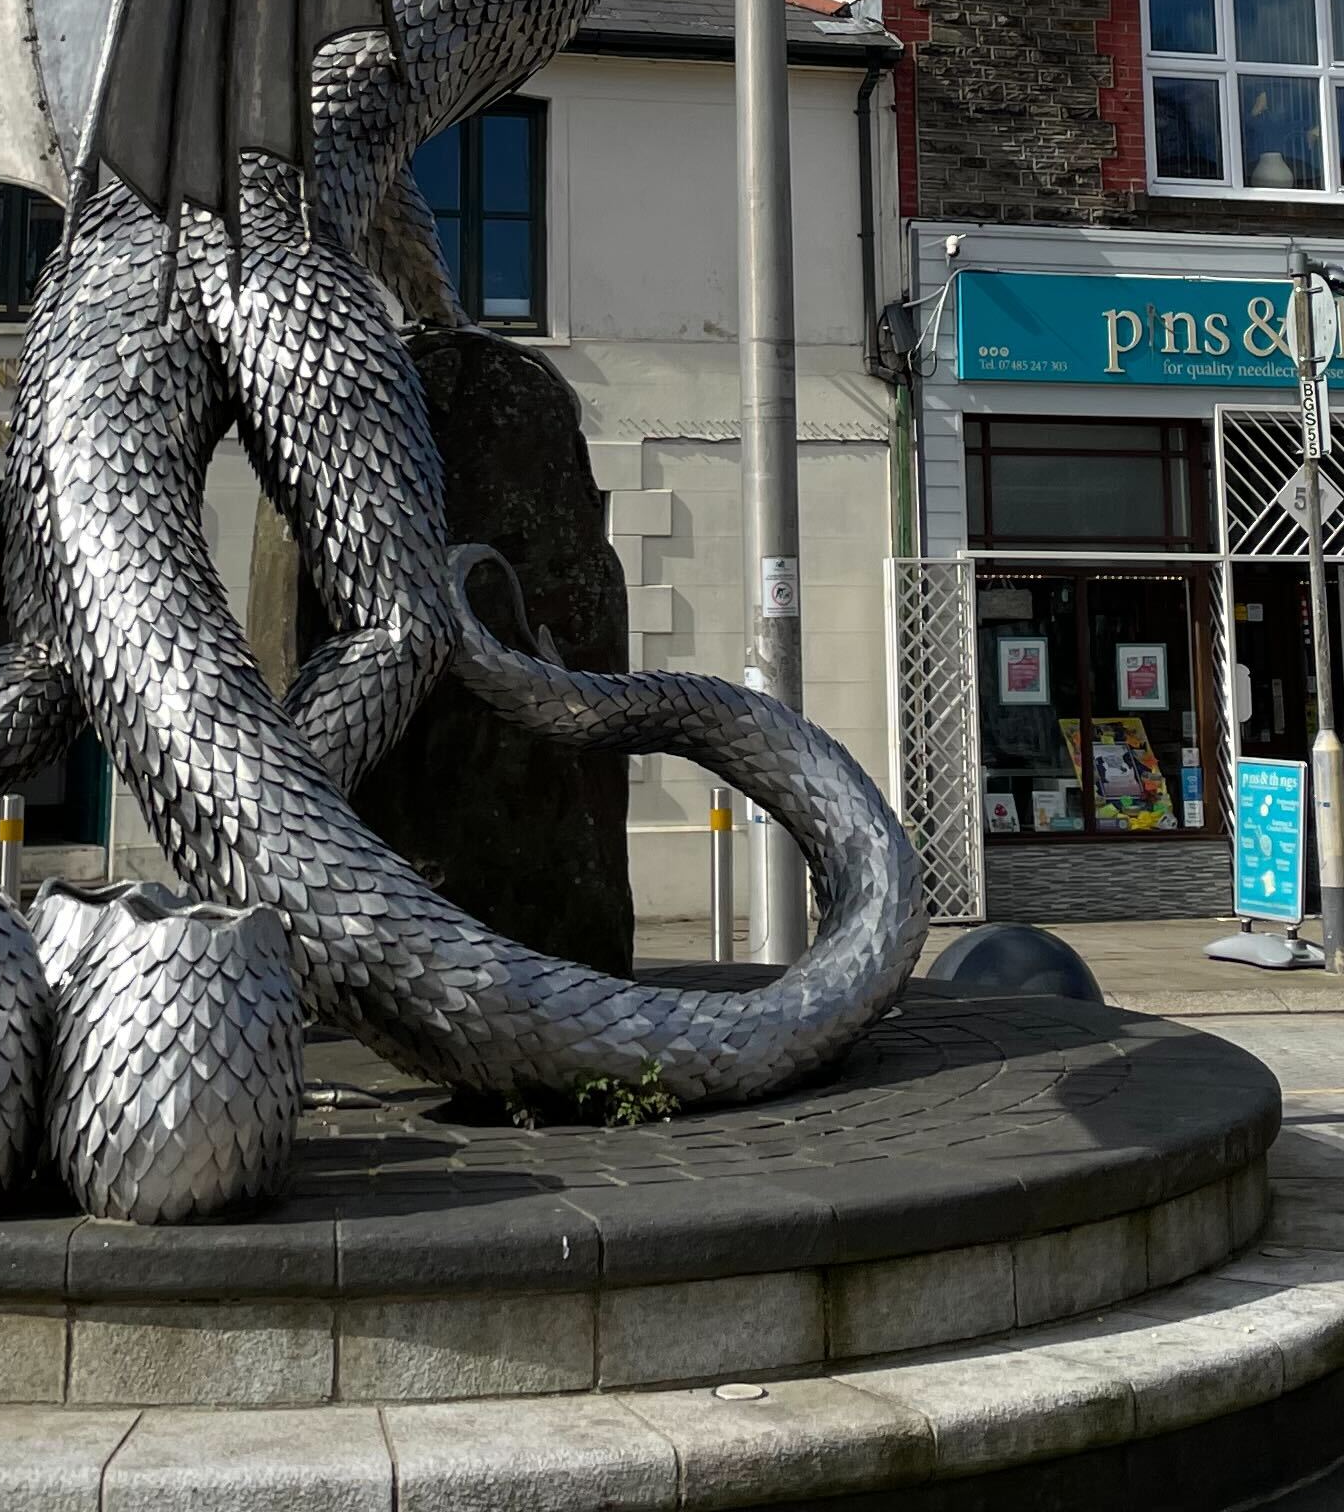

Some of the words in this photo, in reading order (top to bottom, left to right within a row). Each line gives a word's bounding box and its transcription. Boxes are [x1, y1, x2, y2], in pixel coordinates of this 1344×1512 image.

[1243, 296, 1294, 357] &
[1030, 361, 1048, 371] 247
[1163, 359, 1183, 375] for
[1187, 361, 1234, 380] quality
[1238, 361, 1298, 378] needlecr
